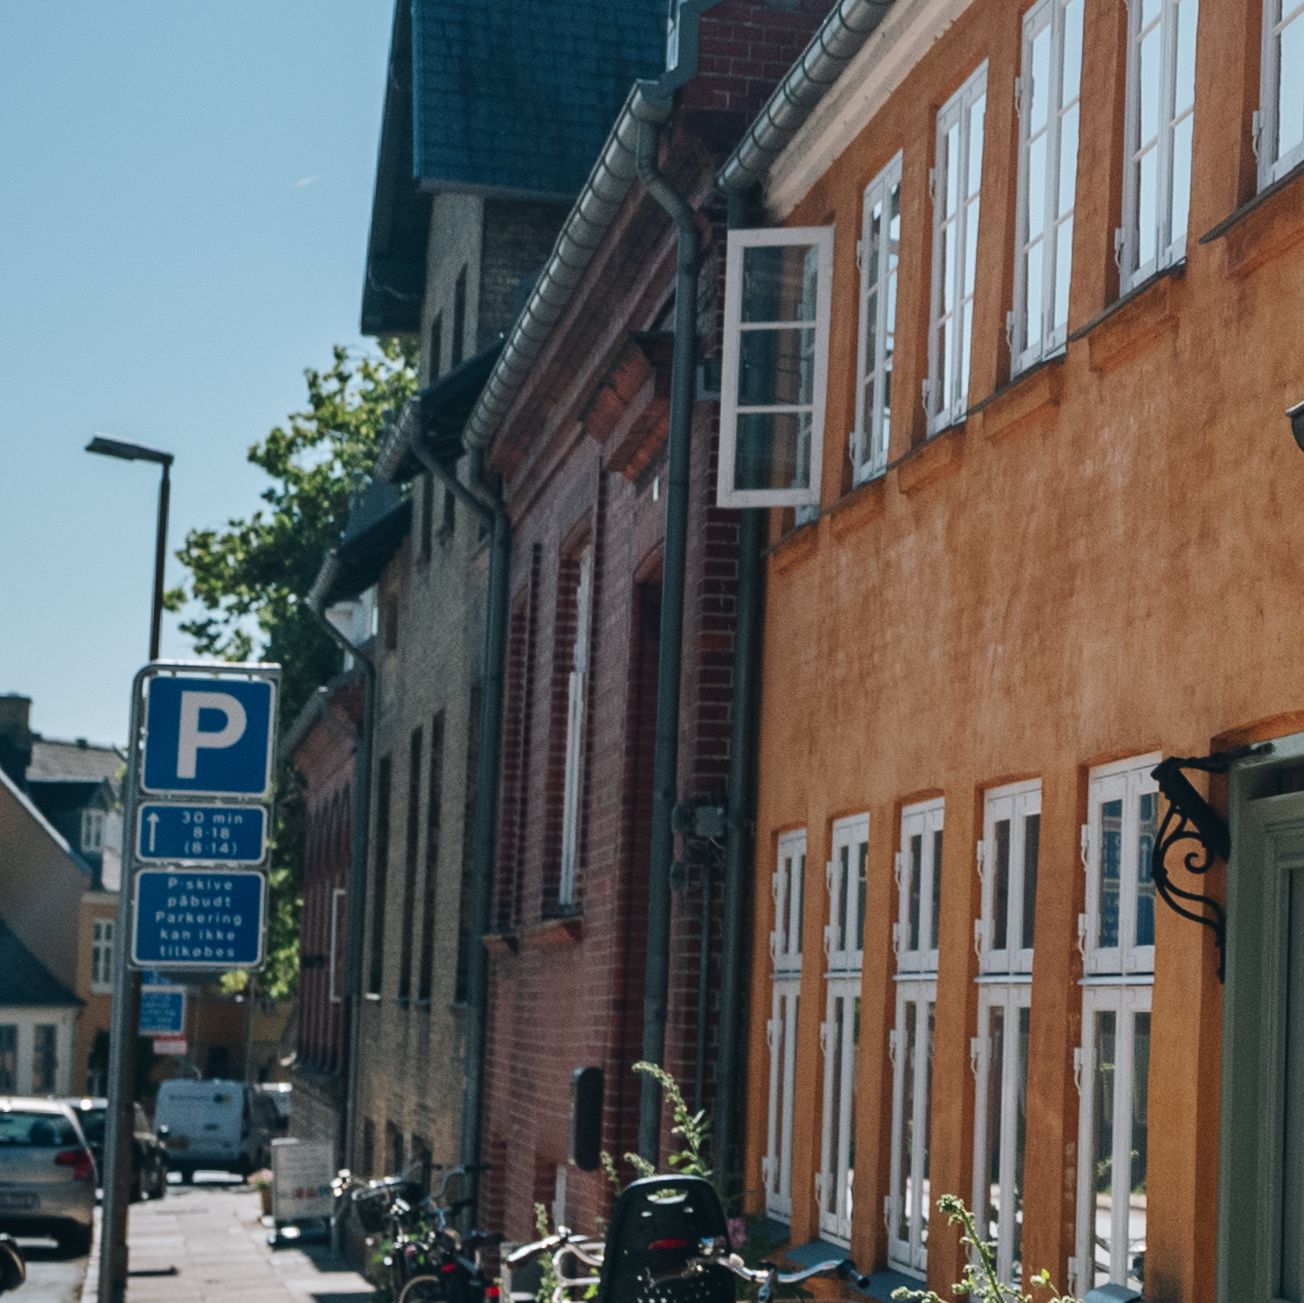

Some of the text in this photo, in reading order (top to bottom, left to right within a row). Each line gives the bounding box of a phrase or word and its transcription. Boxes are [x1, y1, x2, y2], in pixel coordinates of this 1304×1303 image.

[177, 691, 248, 780] P
[182, 810, 244, 825] 30 min
[167, 895, 231, 908] påbudt
[155, 910, 242, 927] Parkering
[160, 928, 235, 941] kan ikke
